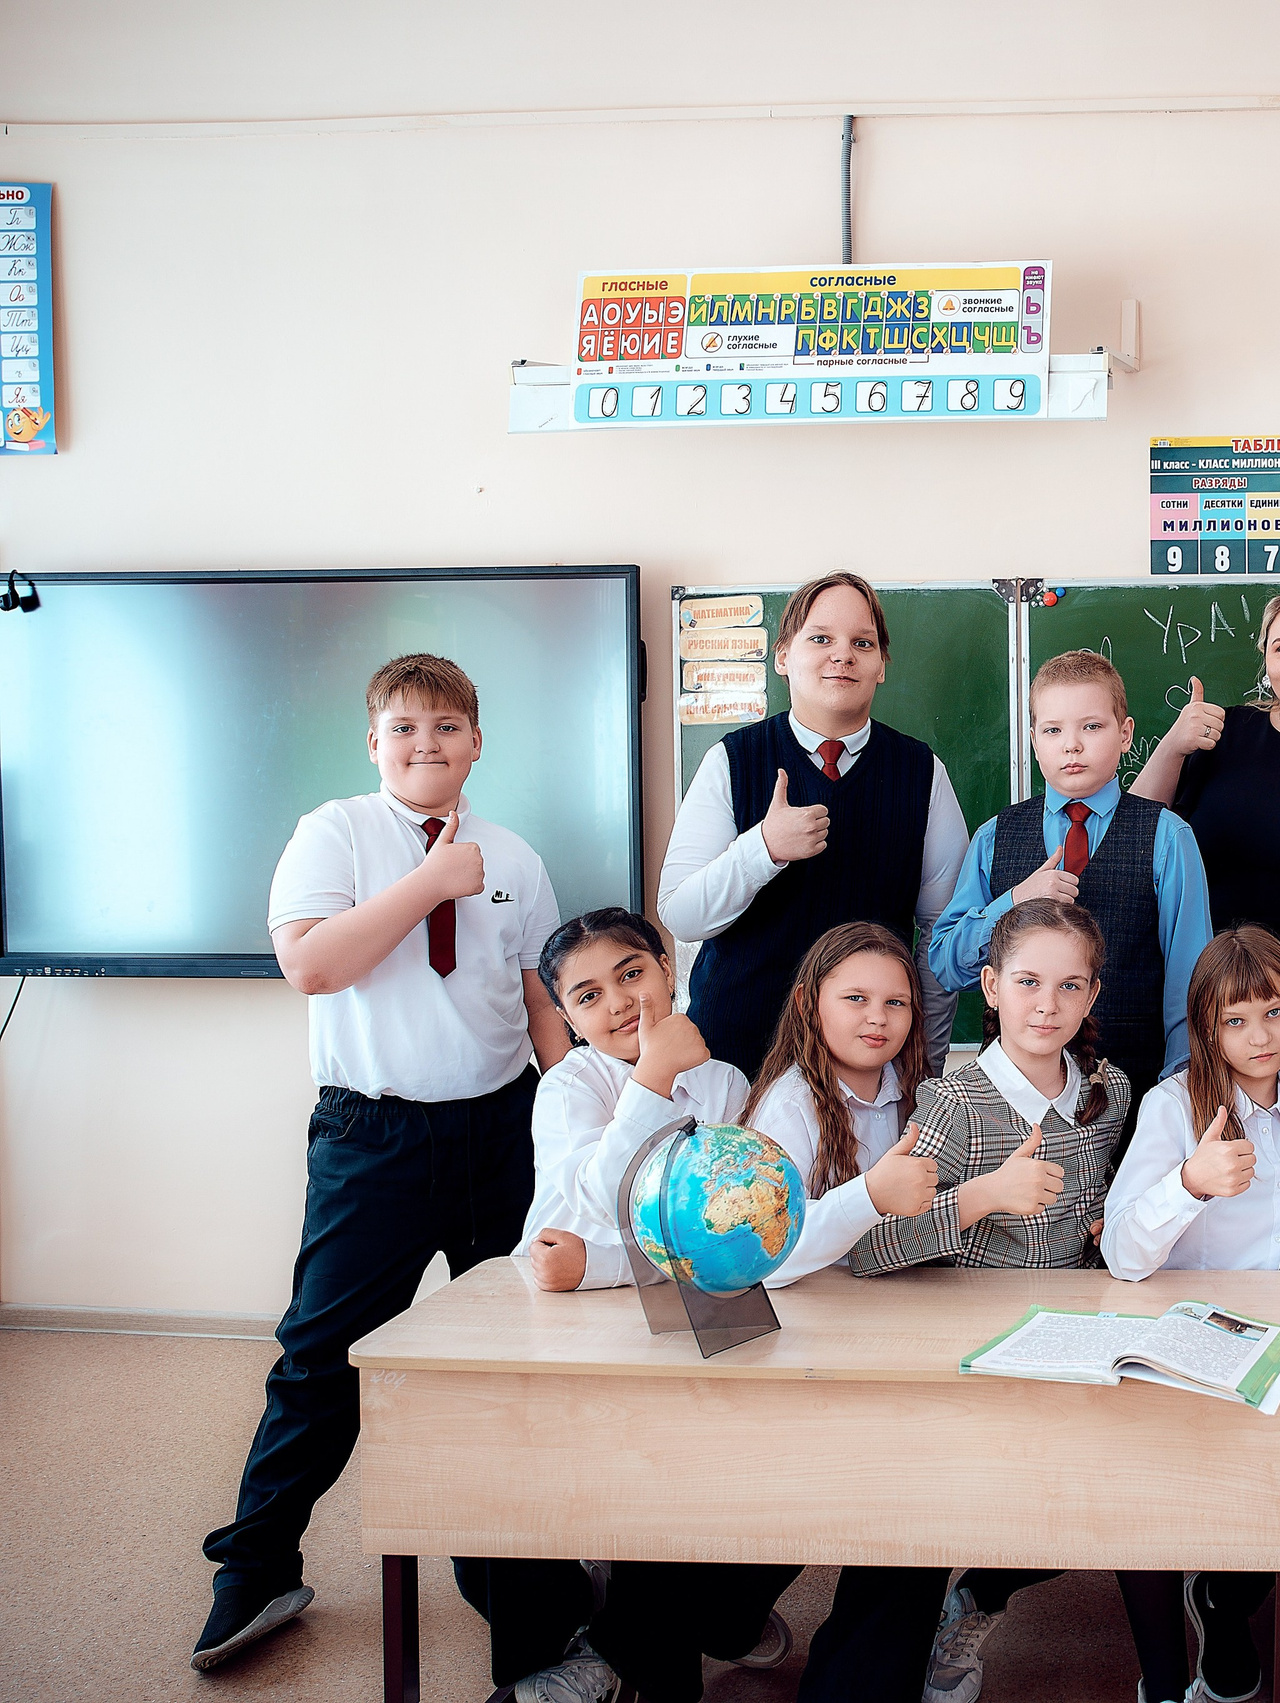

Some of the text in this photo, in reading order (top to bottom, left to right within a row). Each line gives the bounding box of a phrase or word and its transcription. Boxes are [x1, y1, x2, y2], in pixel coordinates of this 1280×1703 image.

[601, 279, 669, 292] гласные
[809, 273, 897, 287] согласные
[962, 296, 1003, 305] звонкие
[962, 304, 1014, 313] согласные
[727, 333, 760, 343] глухие
[727, 341, 778, 350] согласные
[816, 356, 908, 368] парные согласные
[601, 380, 1025, 417] 0 1 2 3 4 5 6 7 8 9
[1151, 460, 1161, 469] III
[1163, 461, 1190, 470] класс
[1199, 459, 1229, 468] КЛАСС
[1193, 478, 1247, 489] РАЗРЯДЫ
[1160, 500, 1189, 508] СОТНИ
[1204, 500, 1243, 509] ДЕСЯТКИ
[1167, 546, 1183, 572] 9
[1214, 546, 1230, 572] 8
[1263, 545, 1279, 571] 7
[693, 606, 751, 620] МАТЕМАТИКА
[687, 638, 759, 650] РУССКИЙ ЯЗЫК
